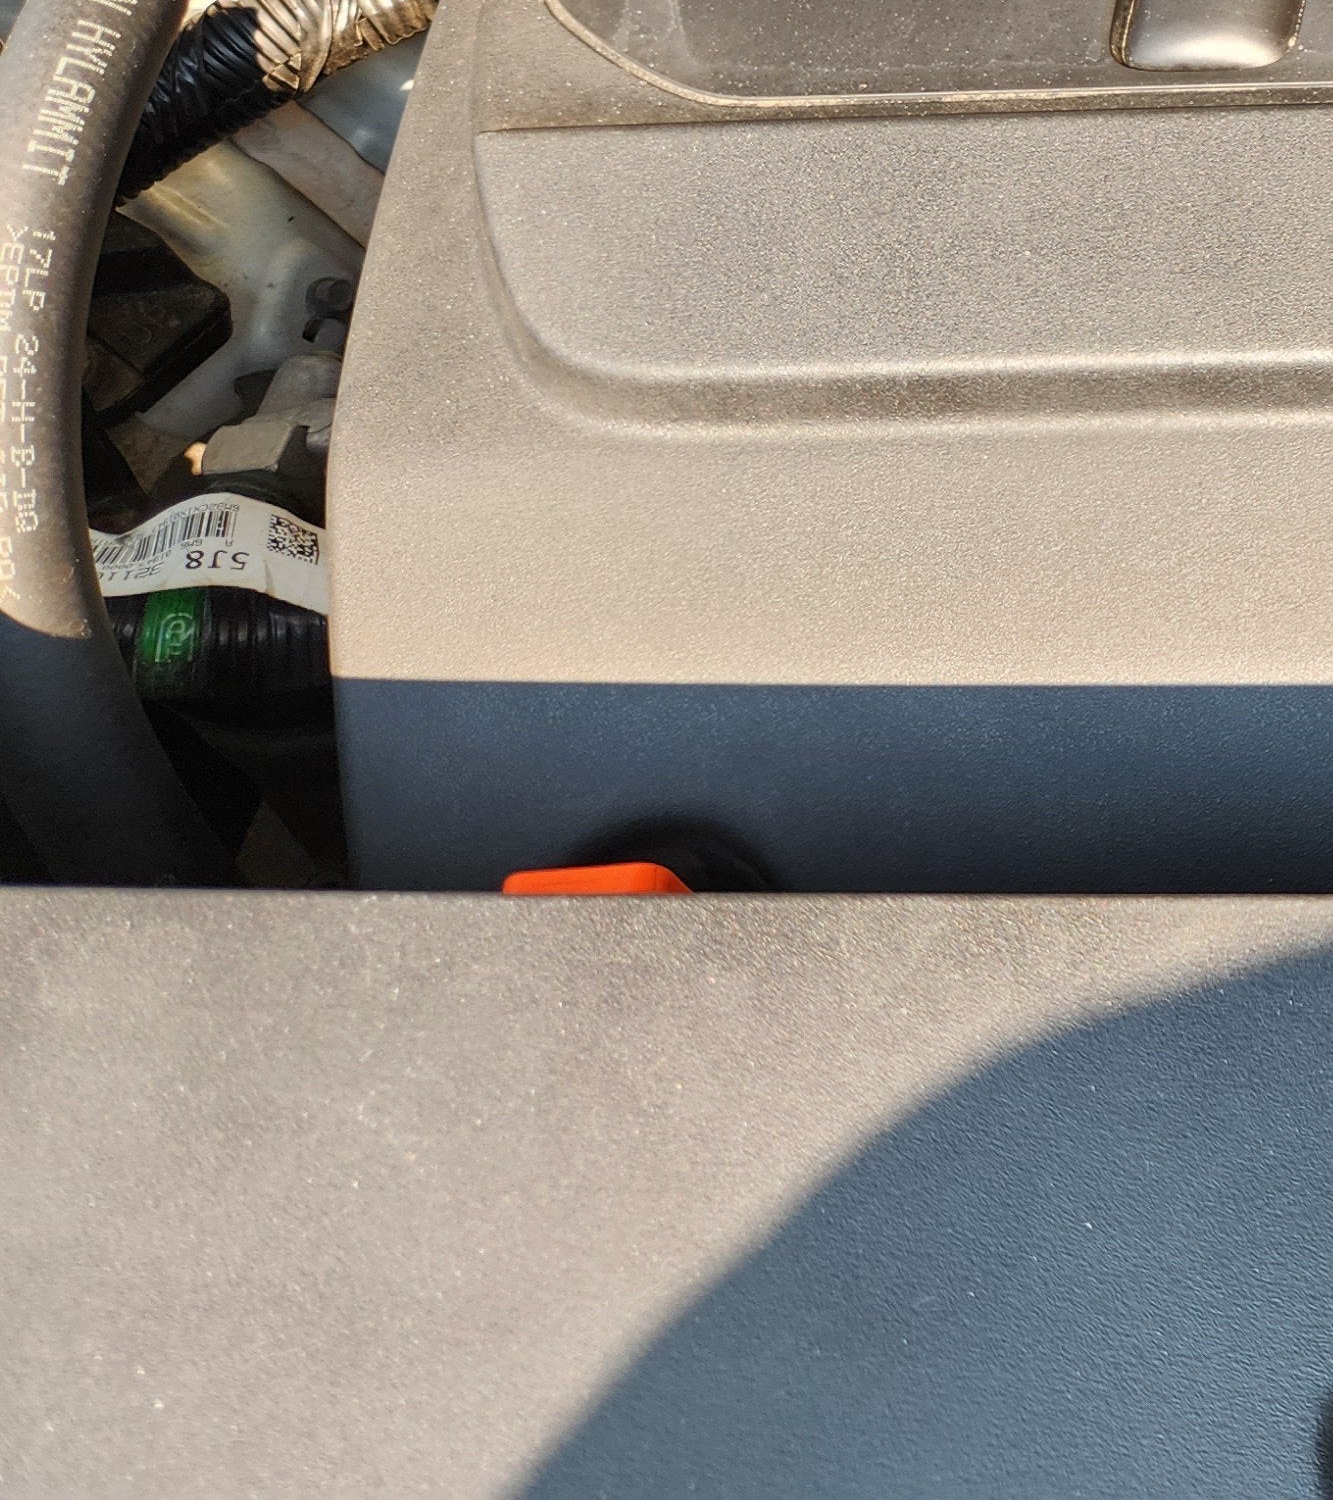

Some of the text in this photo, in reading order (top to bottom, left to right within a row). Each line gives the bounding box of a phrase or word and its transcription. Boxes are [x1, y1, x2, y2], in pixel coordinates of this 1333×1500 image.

[22, 18, 123, 187] HYLAMMIT
[22, 227, 57, 312] 17LP
[184, 549, 250, 571] 5J8
